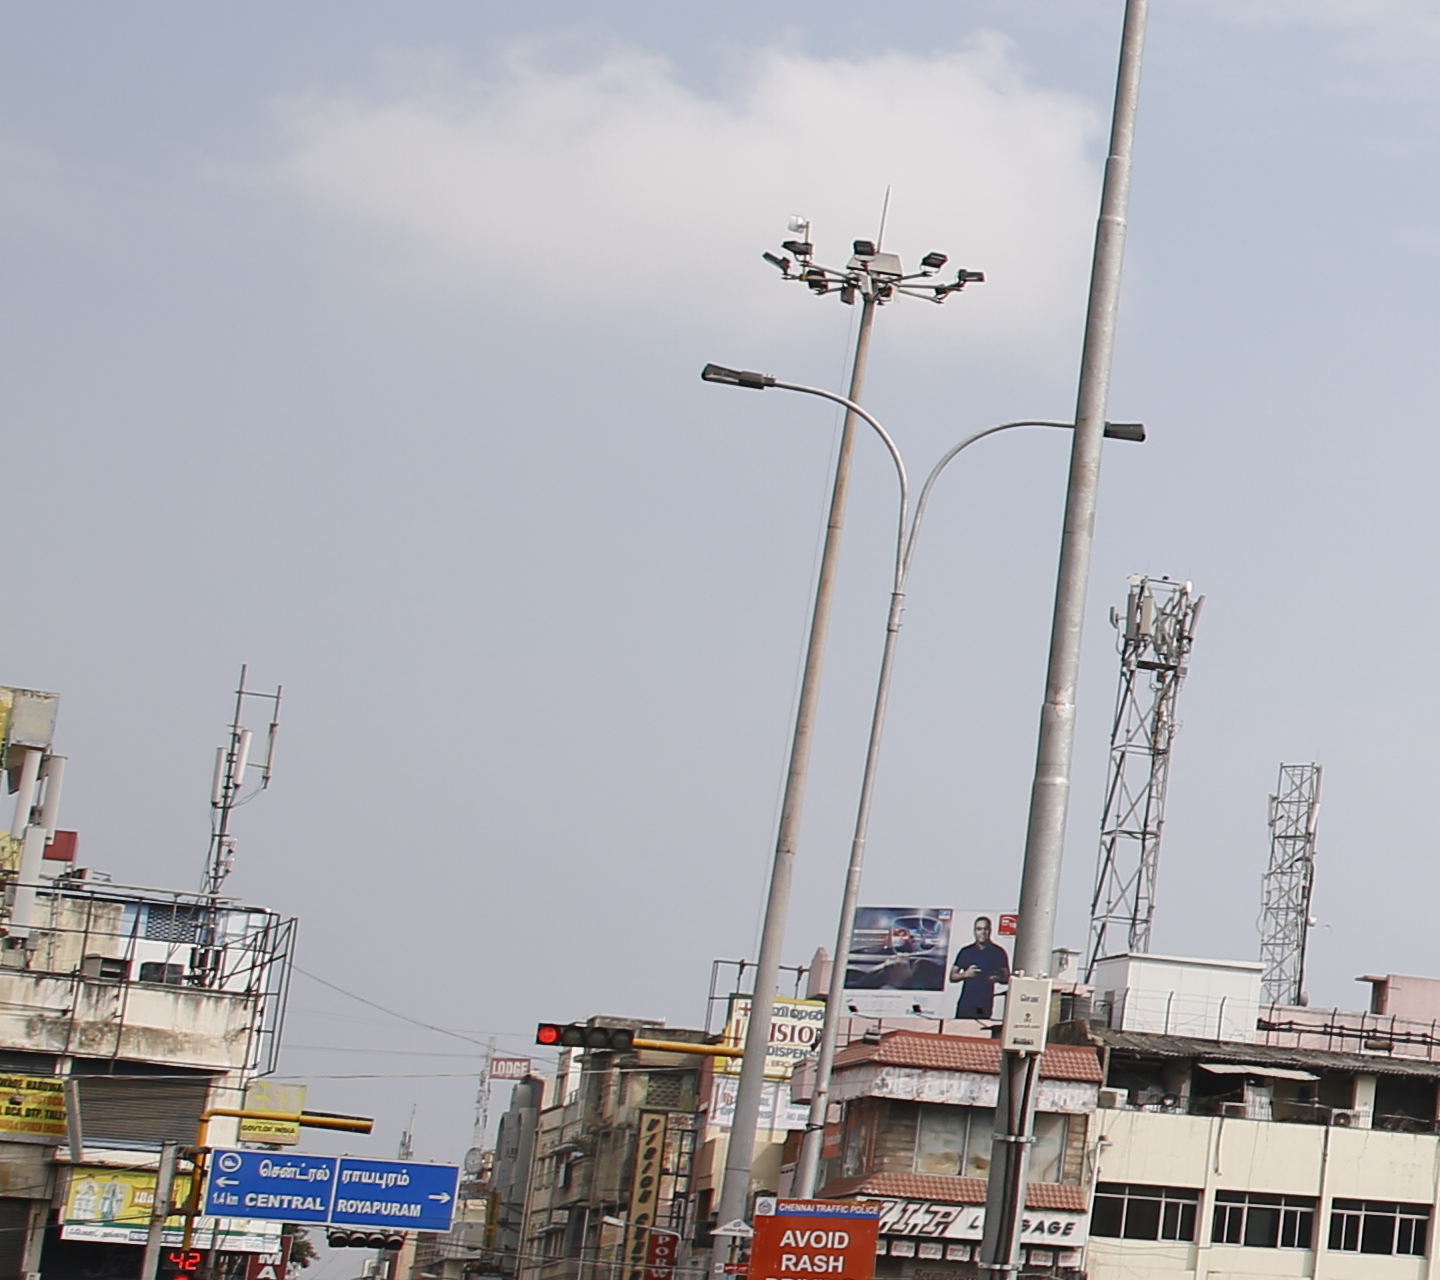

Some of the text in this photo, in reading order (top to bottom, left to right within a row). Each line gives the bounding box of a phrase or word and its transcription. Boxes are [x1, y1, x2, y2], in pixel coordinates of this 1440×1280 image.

[491, 1059, 528, 1075] LODGE
[259, 1158, 410, 1189] சென்ட்ரல் ராயபுரம்
[227, 1193, 239, 1206] km
[244, 1193, 421, 1217] CENTRAL ROYAPURAM
[779, 1203, 879, 1215] CHENNAI TRAFFIC POLICE
[780, 1230, 849, 1249] AVOID
[169, 1252, 201, 1271] 42
[781, 1254, 844, 1273] RASH
